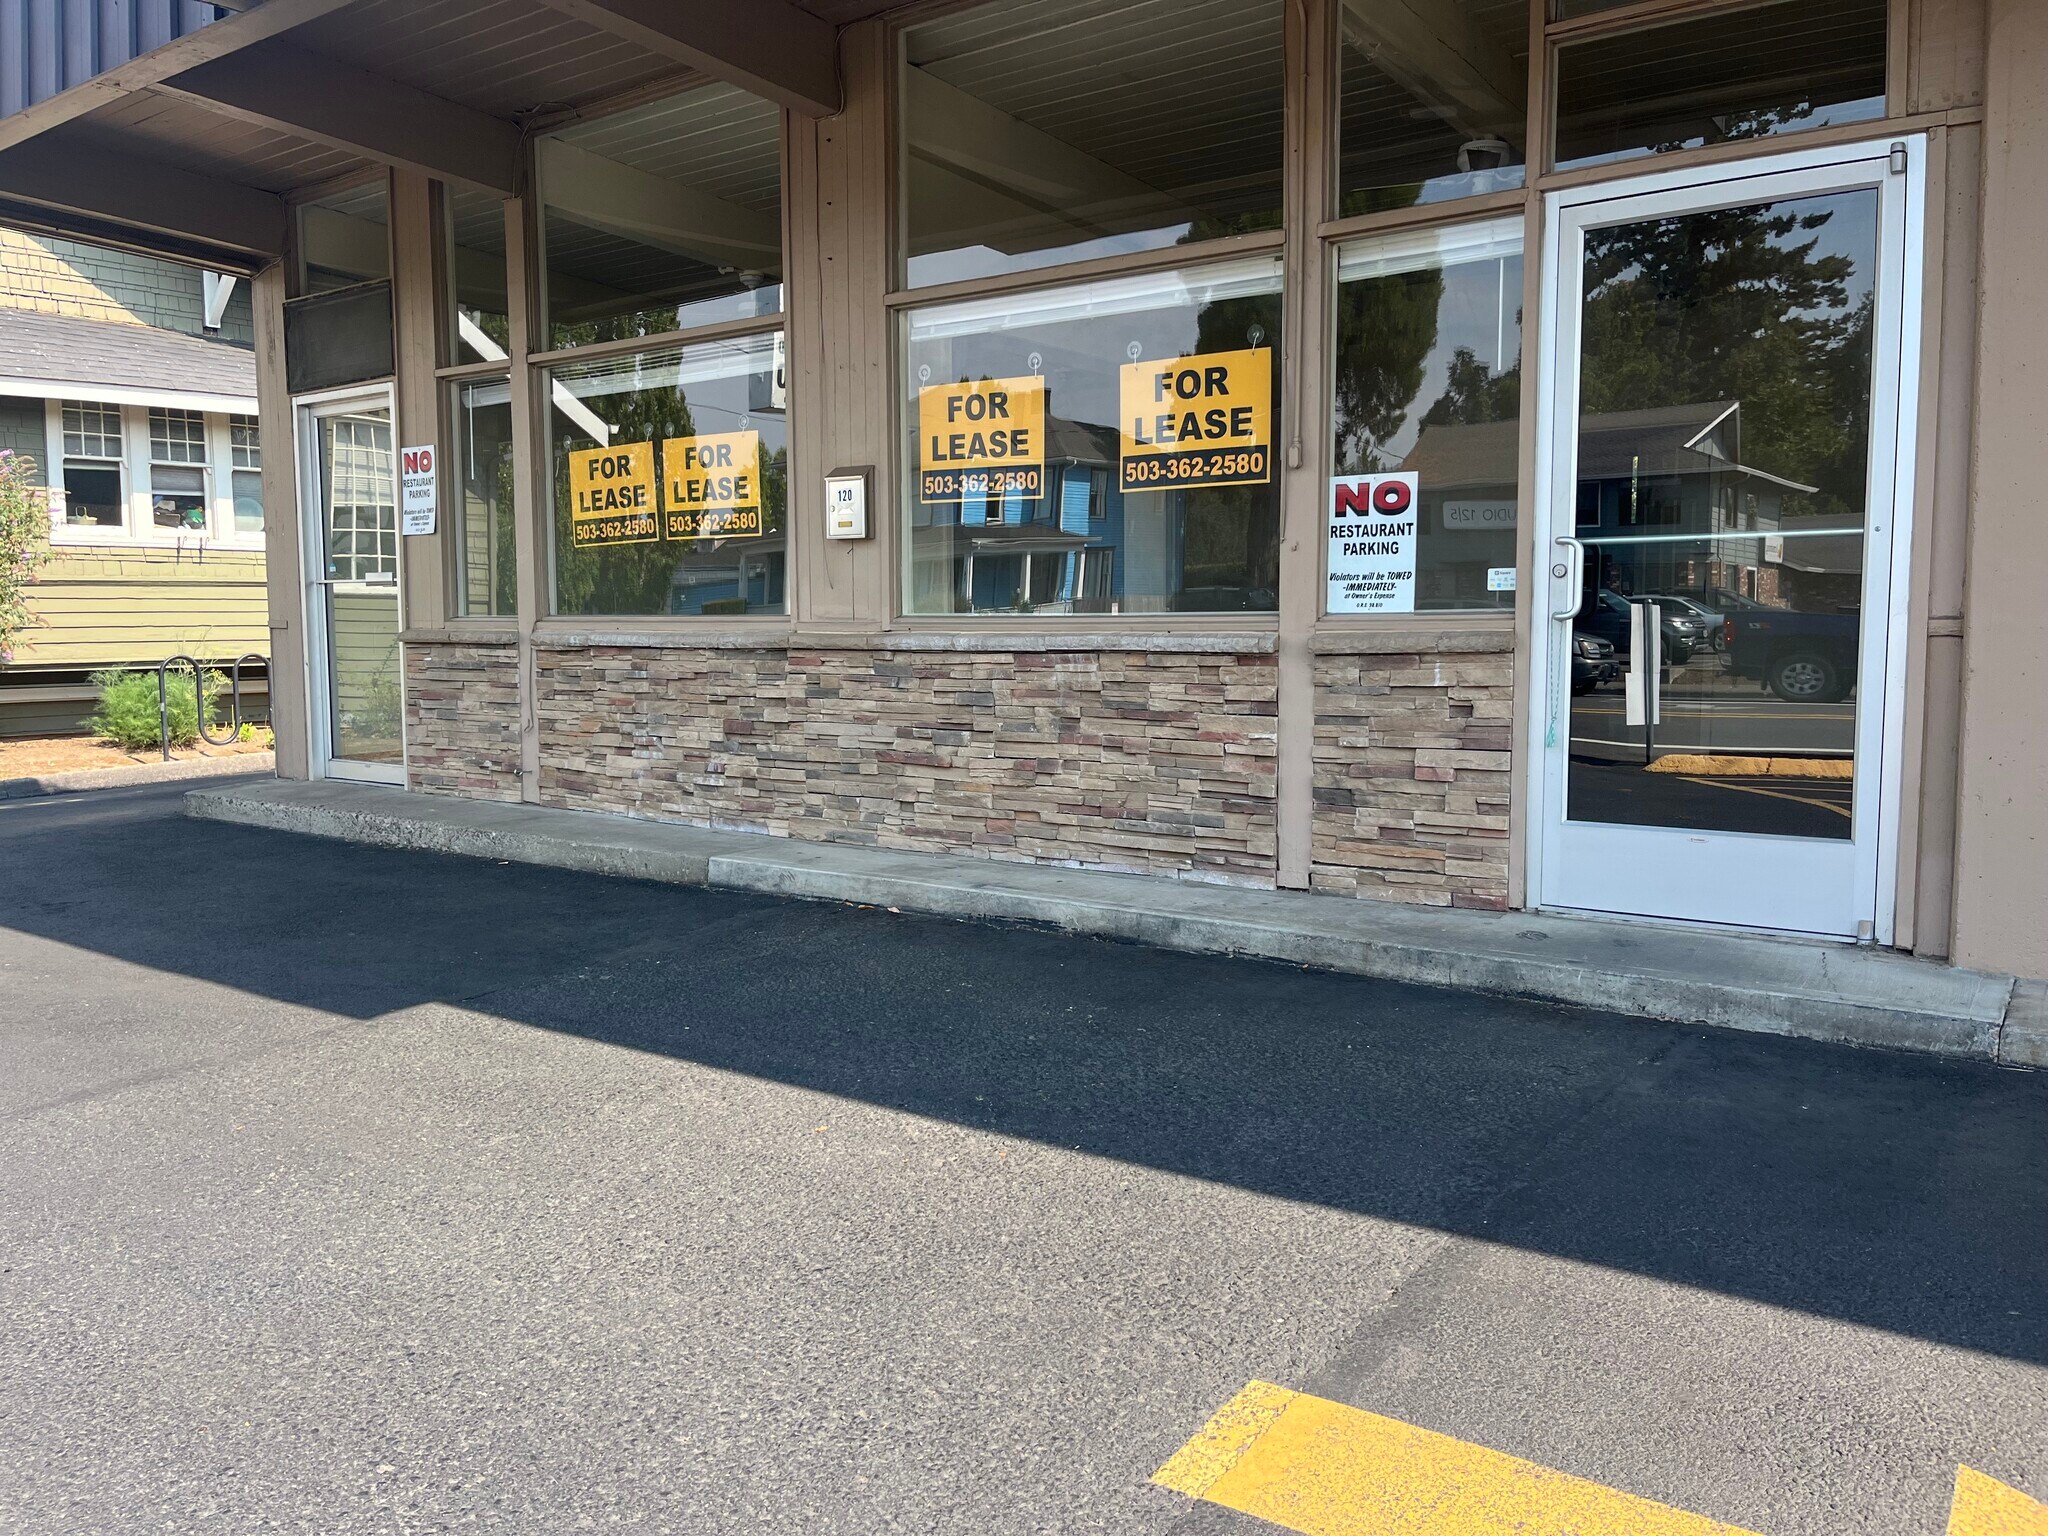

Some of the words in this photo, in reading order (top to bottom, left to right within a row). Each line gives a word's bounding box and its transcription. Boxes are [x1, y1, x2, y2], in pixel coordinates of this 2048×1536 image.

[1154, 366, 1229, 403] FOR
[947, 391, 1010, 423] FOR
[1134, 406, 1253, 446] LEASE
[684, 443, 733, 470] FOR
[931, 428, 1029, 462] LEASE
[403, 450, 433, 475] NO
[588, 454, 632, 481] FOR
[1125, 452, 1264, 483] 503-362-2580
[403, 477, 435, 488] RESTAURANT
[409, 489, 431, 499] PARKING
[673, 475, 749, 504] LEASE
[924, 470, 1039, 495] 503-362-2580
[579, 484, 647, 513] LEASE
[837, 489, 853, 502] 120
[1334, 480, 1412, 518] NO
[576, 518, 655, 541] 503-362-2580
[668, 511, 757, 533] 503-362-2580
[1330, 522, 1414, 539] RESTAURANT
[1343, 541, 1400, 556] PARKING
[1329, 572, 1361, 582] Violators
[1361, 572, 1375, 581] will
[1376, 572, 1386, 581] be
[1387, 571, 1413, 581] TOWED
[1373, 592, 1396, 600] Expense
